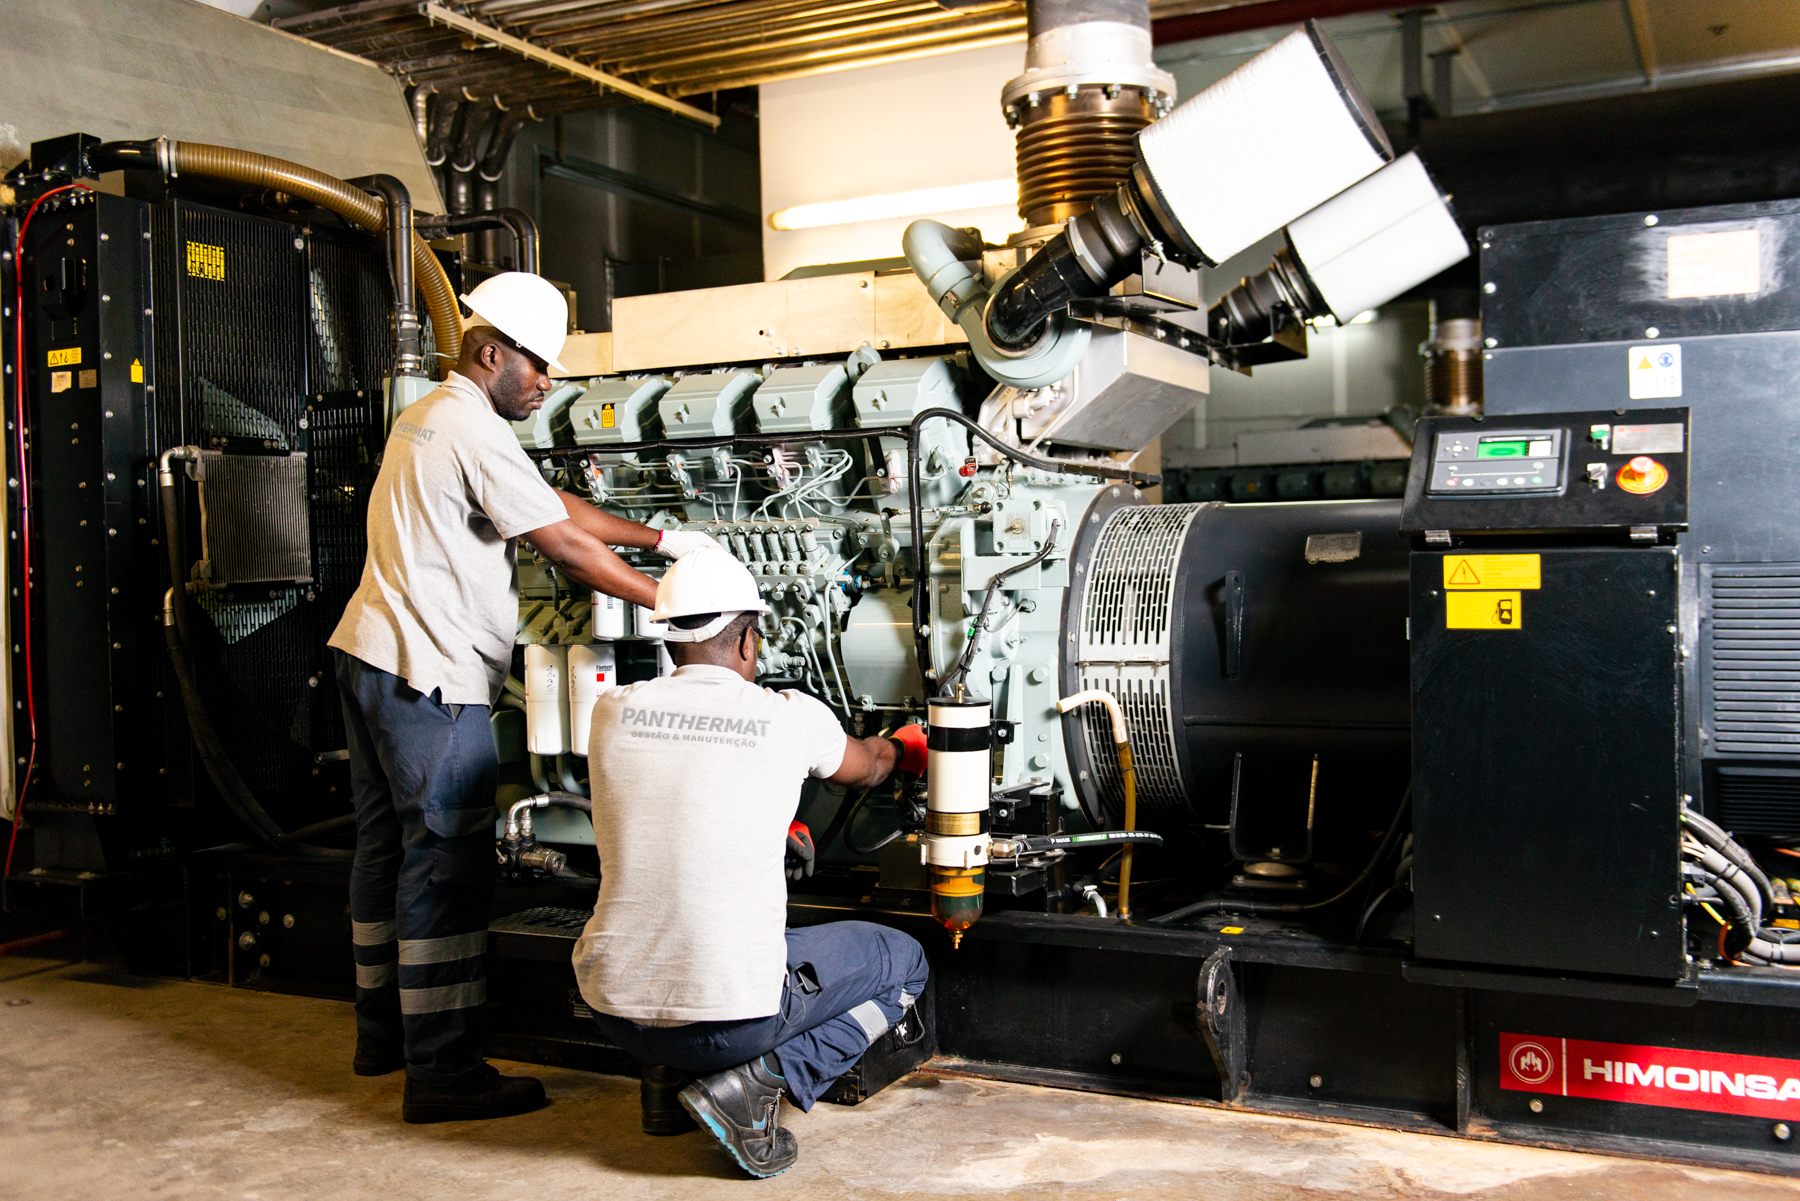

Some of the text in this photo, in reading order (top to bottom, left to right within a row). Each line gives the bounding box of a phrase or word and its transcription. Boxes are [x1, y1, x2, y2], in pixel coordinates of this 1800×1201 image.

[394, 421, 436, 442] HERMAT
[620, 707, 771, 737] PANTHERMAT
[631, 731, 669, 740] GESTÃO
[682, 734, 756, 748] MANUTENÇÃO
[1583, 1058, 1800, 1101] HIMOINSA
